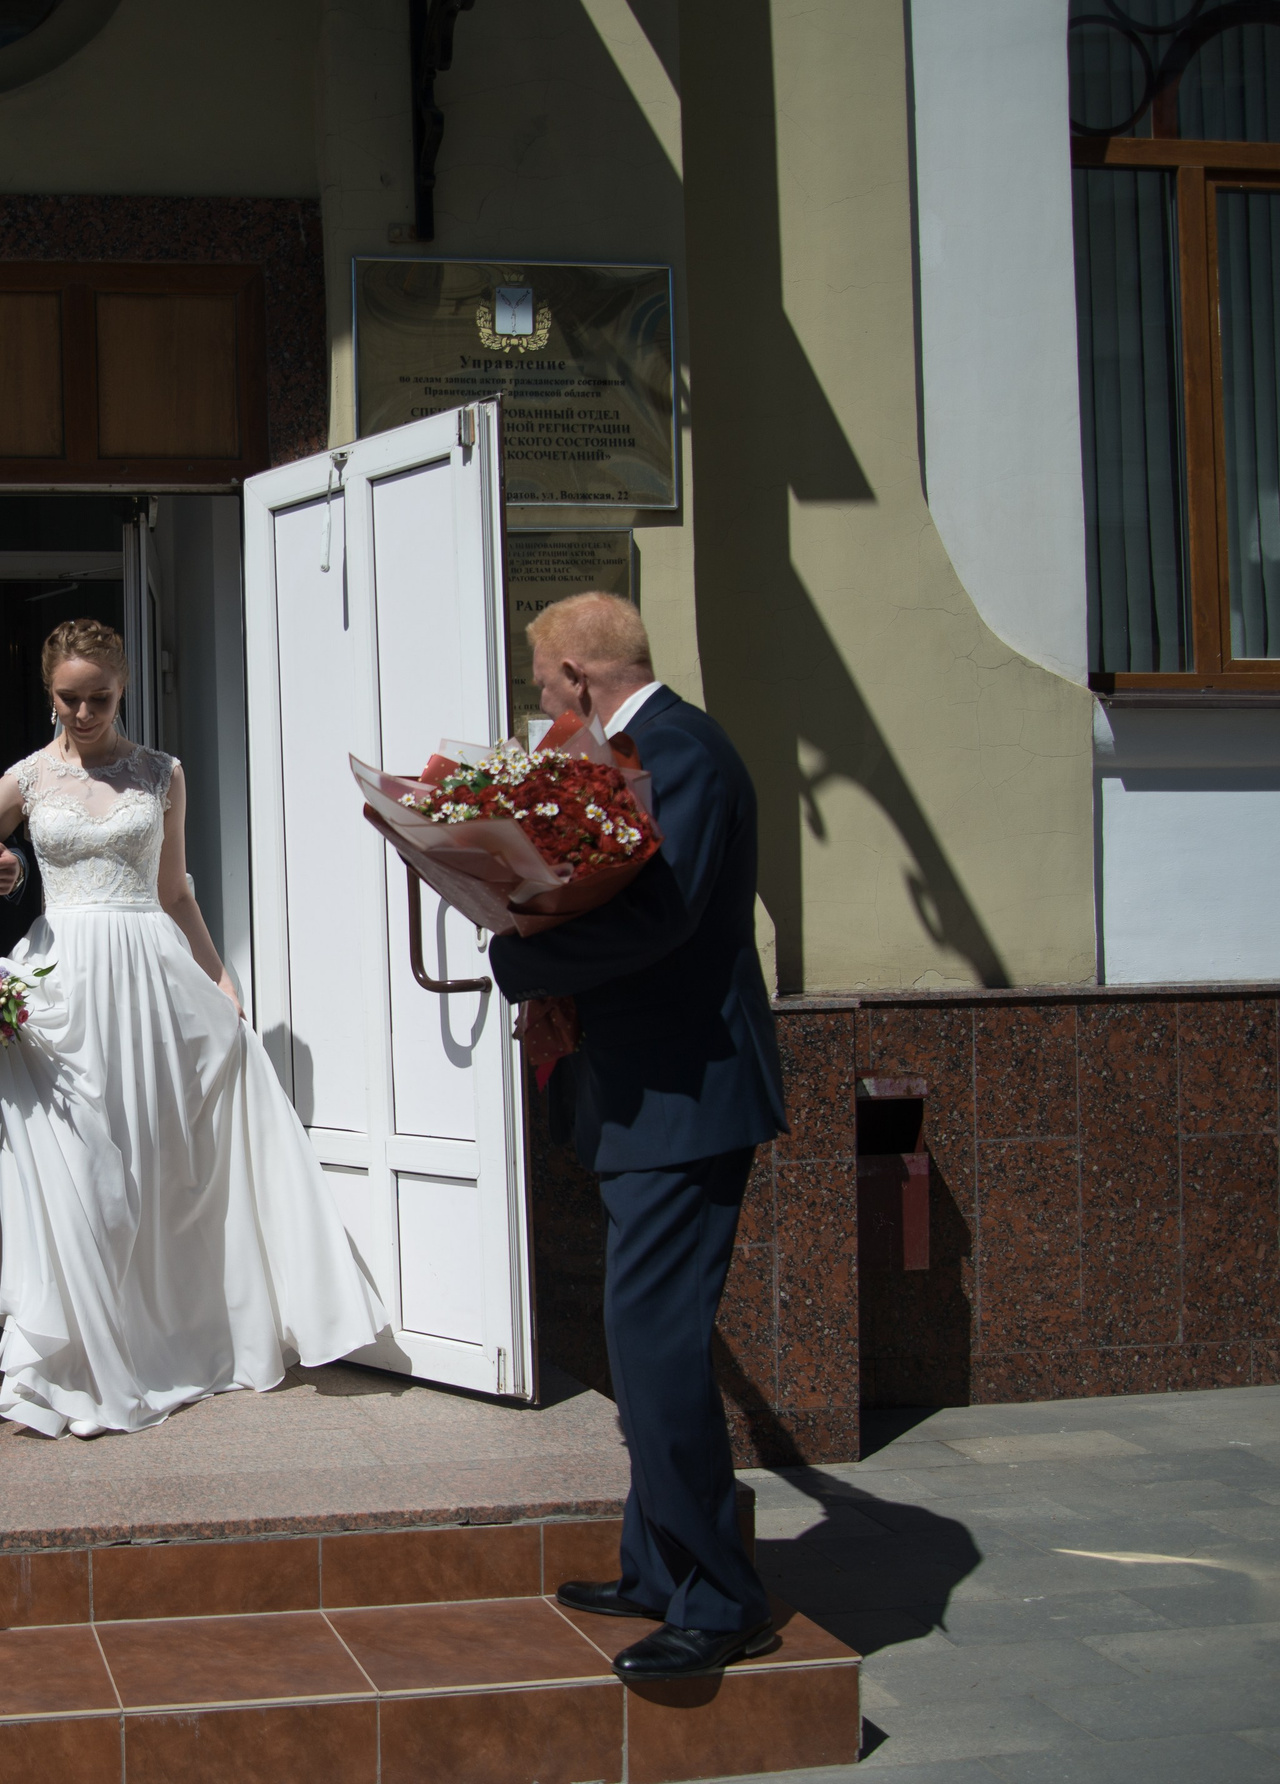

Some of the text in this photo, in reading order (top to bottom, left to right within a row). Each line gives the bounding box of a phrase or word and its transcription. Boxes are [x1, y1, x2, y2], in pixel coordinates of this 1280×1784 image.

[459, 354, 565, 373] Управление
[399, 376, 626, 388] по делам записи актов гражданского состояния
[564, 389, 602, 398] области
[577, 409, 620, 421] ОТДЕЛ
[537, 423, 631, 435] РЕГИСТРАЦИИ
[554, 437, 636, 448] СОСТОЯНИЯ
[541, 491, 559, 502] ул.
[560, 490, 616, 501] Волжская,
[617, 490, 630, 501] 22
[581, 542, 613, 550] ОТДЕЛА
[569, 550, 596, 558] АКТОВ
[523, 567, 551, 575] ДЕЛАМ
